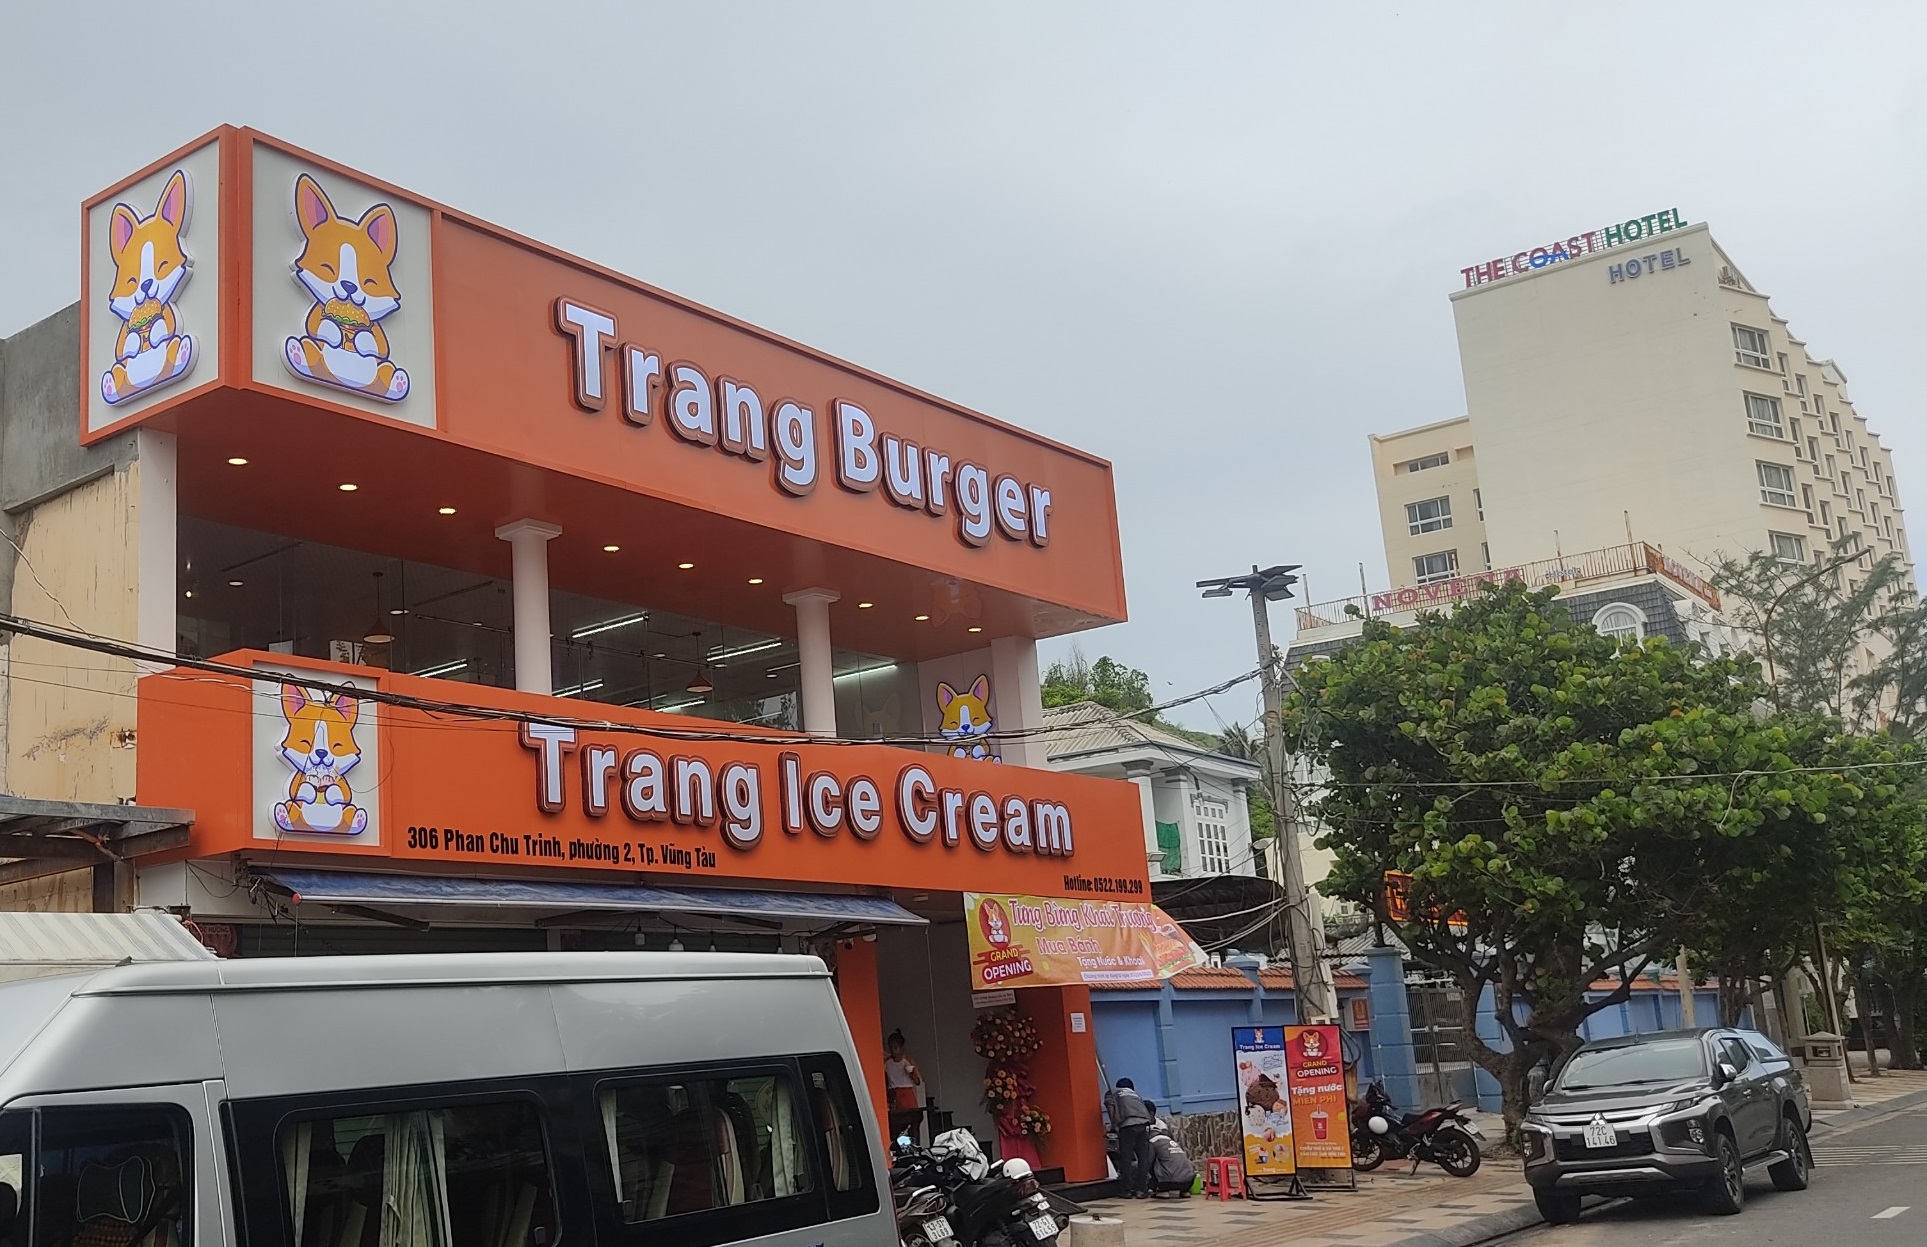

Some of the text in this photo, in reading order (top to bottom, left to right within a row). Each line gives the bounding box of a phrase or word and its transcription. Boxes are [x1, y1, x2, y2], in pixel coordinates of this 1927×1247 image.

[1460, 207, 1688, 288] THE COAST HOTEL
[1608, 247, 1691, 284] HOTEL
[555, 296, 1054, 548] Trang Burger
[520, 721, 1075, 857] Trang Ice Cream
[407, 826, 716, 870] 306 Phan Chu Trinh, phường 2, Tp. Vũng Tàu
[1064, 875, 1144, 895] Hotline: 0522.199.299
[1080, 903, 1115, 928] Khai
[990, 947, 1019, 963] GRAND
[1036, 937, 1065, 954] Mua
[983, 959, 1033, 981] OPENING
[1296, 1066, 1338, 1078] OPENING
[1302, 1060, 1328, 1068] GRAND
[1291, 1085, 1316, 1097] Tặng
[1590, 1126, 1607, 1136] 72C
